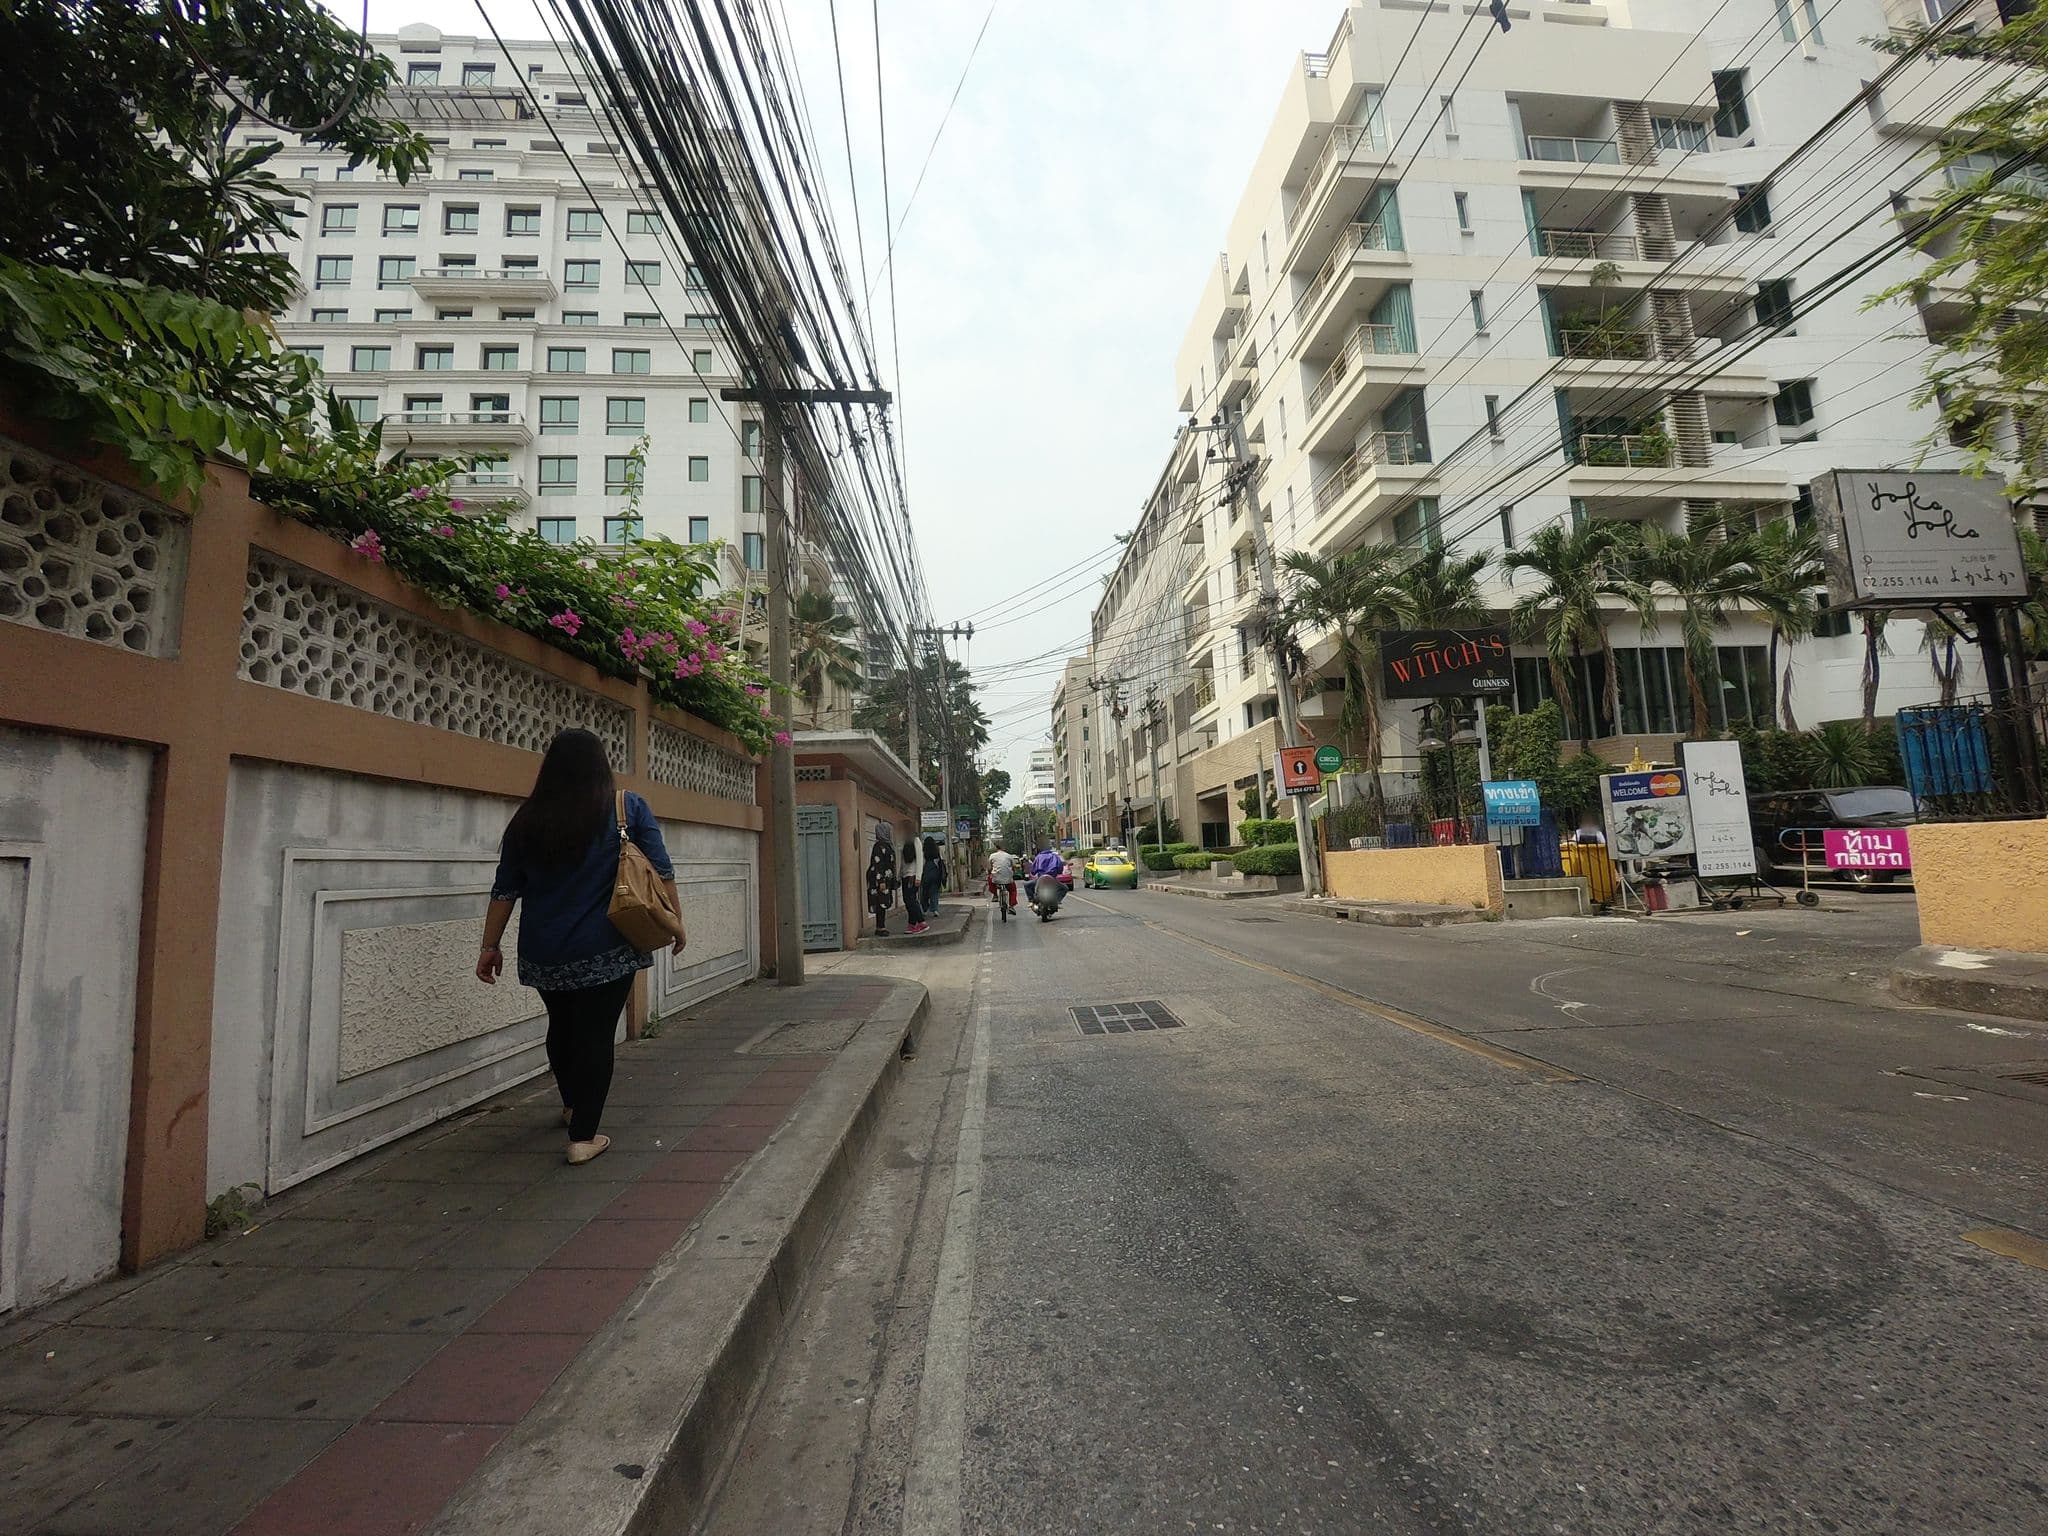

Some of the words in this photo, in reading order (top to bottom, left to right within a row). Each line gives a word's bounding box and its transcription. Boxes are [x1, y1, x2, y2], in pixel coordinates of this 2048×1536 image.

[1863, 576, 1939, 588] 02.255.1144
[1951, 565, 2015, 586] よかよか
[1391, 634, 1504, 683] WITCH'S
[1485, 782, 1536, 799] ทางเข้า
[1612, 787, 1649, 797] WELCOME
[1843, 830, 1892, 850] ห้าม
[1835, 848, 1903, 866] กลับรถ
[1703, 861, 1752, 871] 02.255.1144
